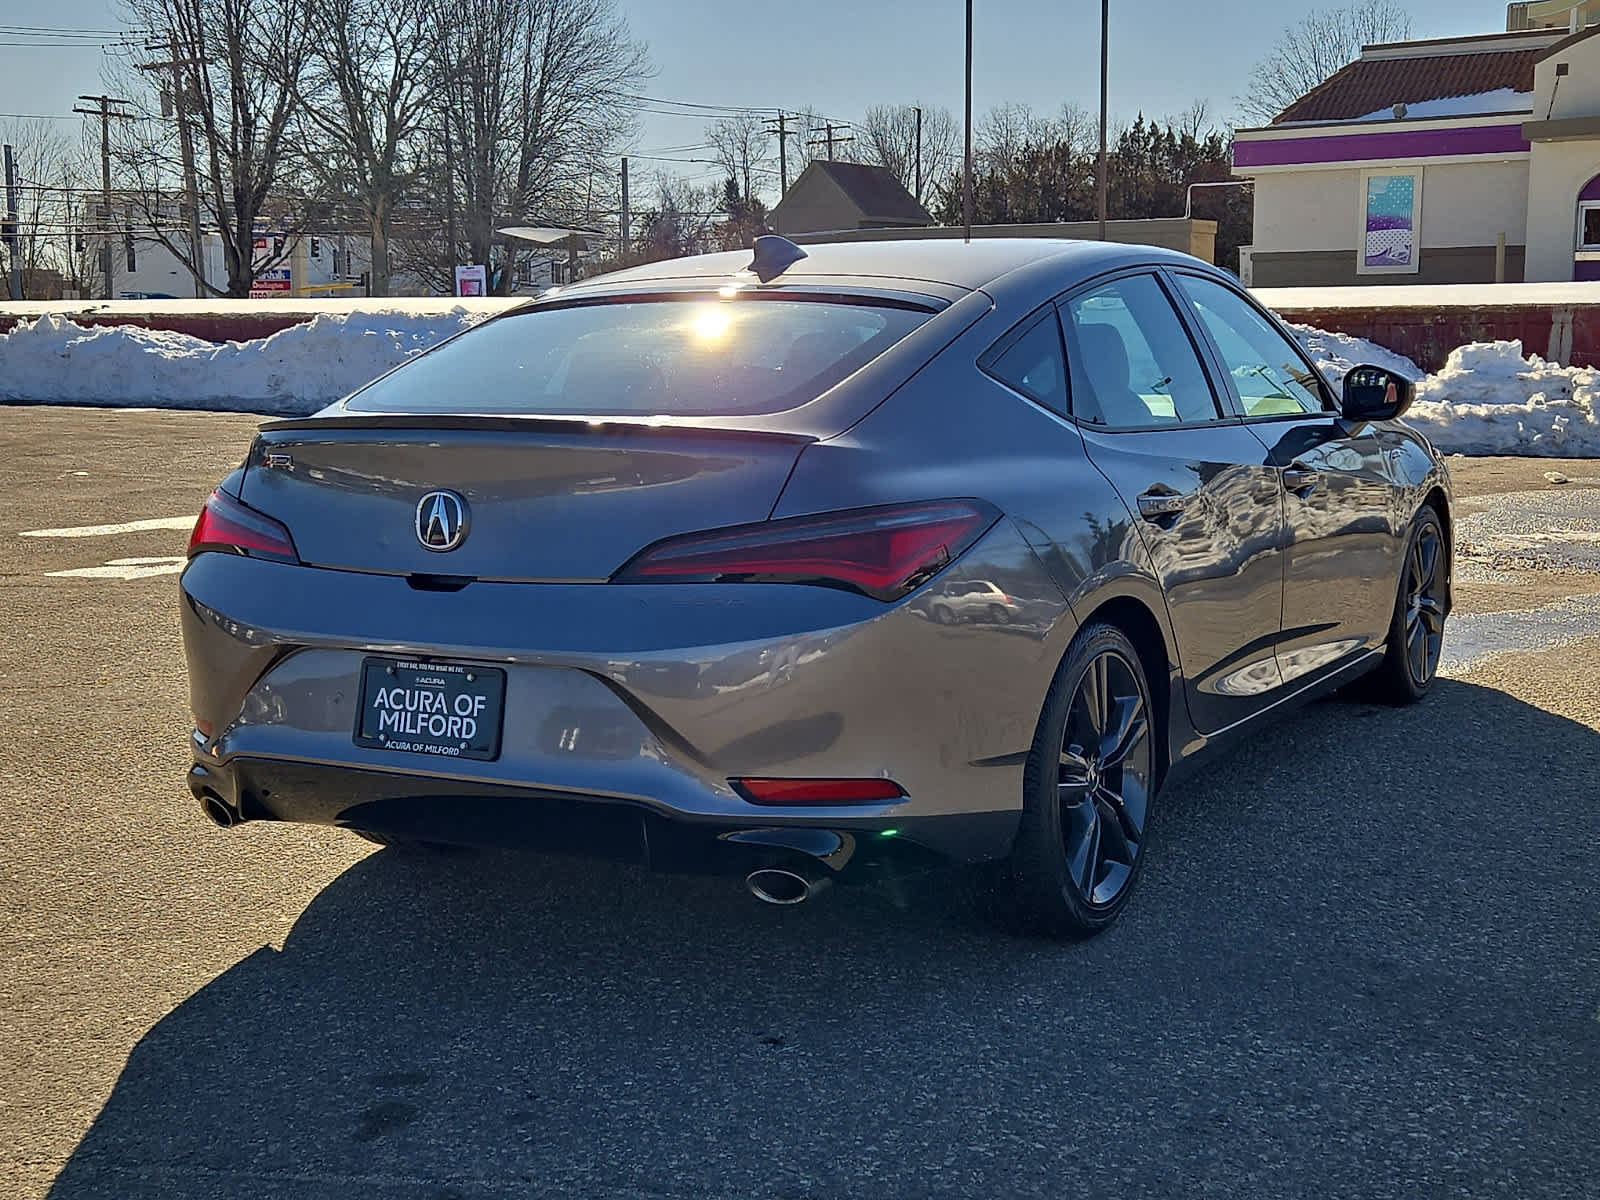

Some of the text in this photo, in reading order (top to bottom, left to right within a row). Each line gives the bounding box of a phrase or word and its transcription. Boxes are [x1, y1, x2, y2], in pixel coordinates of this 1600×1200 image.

[420, 677, 445, 685] ACURA
[373, 687, 486, 717] ACURA OF
[379, 709, 477, 739] MILFORD
[385, 740, 459, 756] ACURA OF MILFORD
